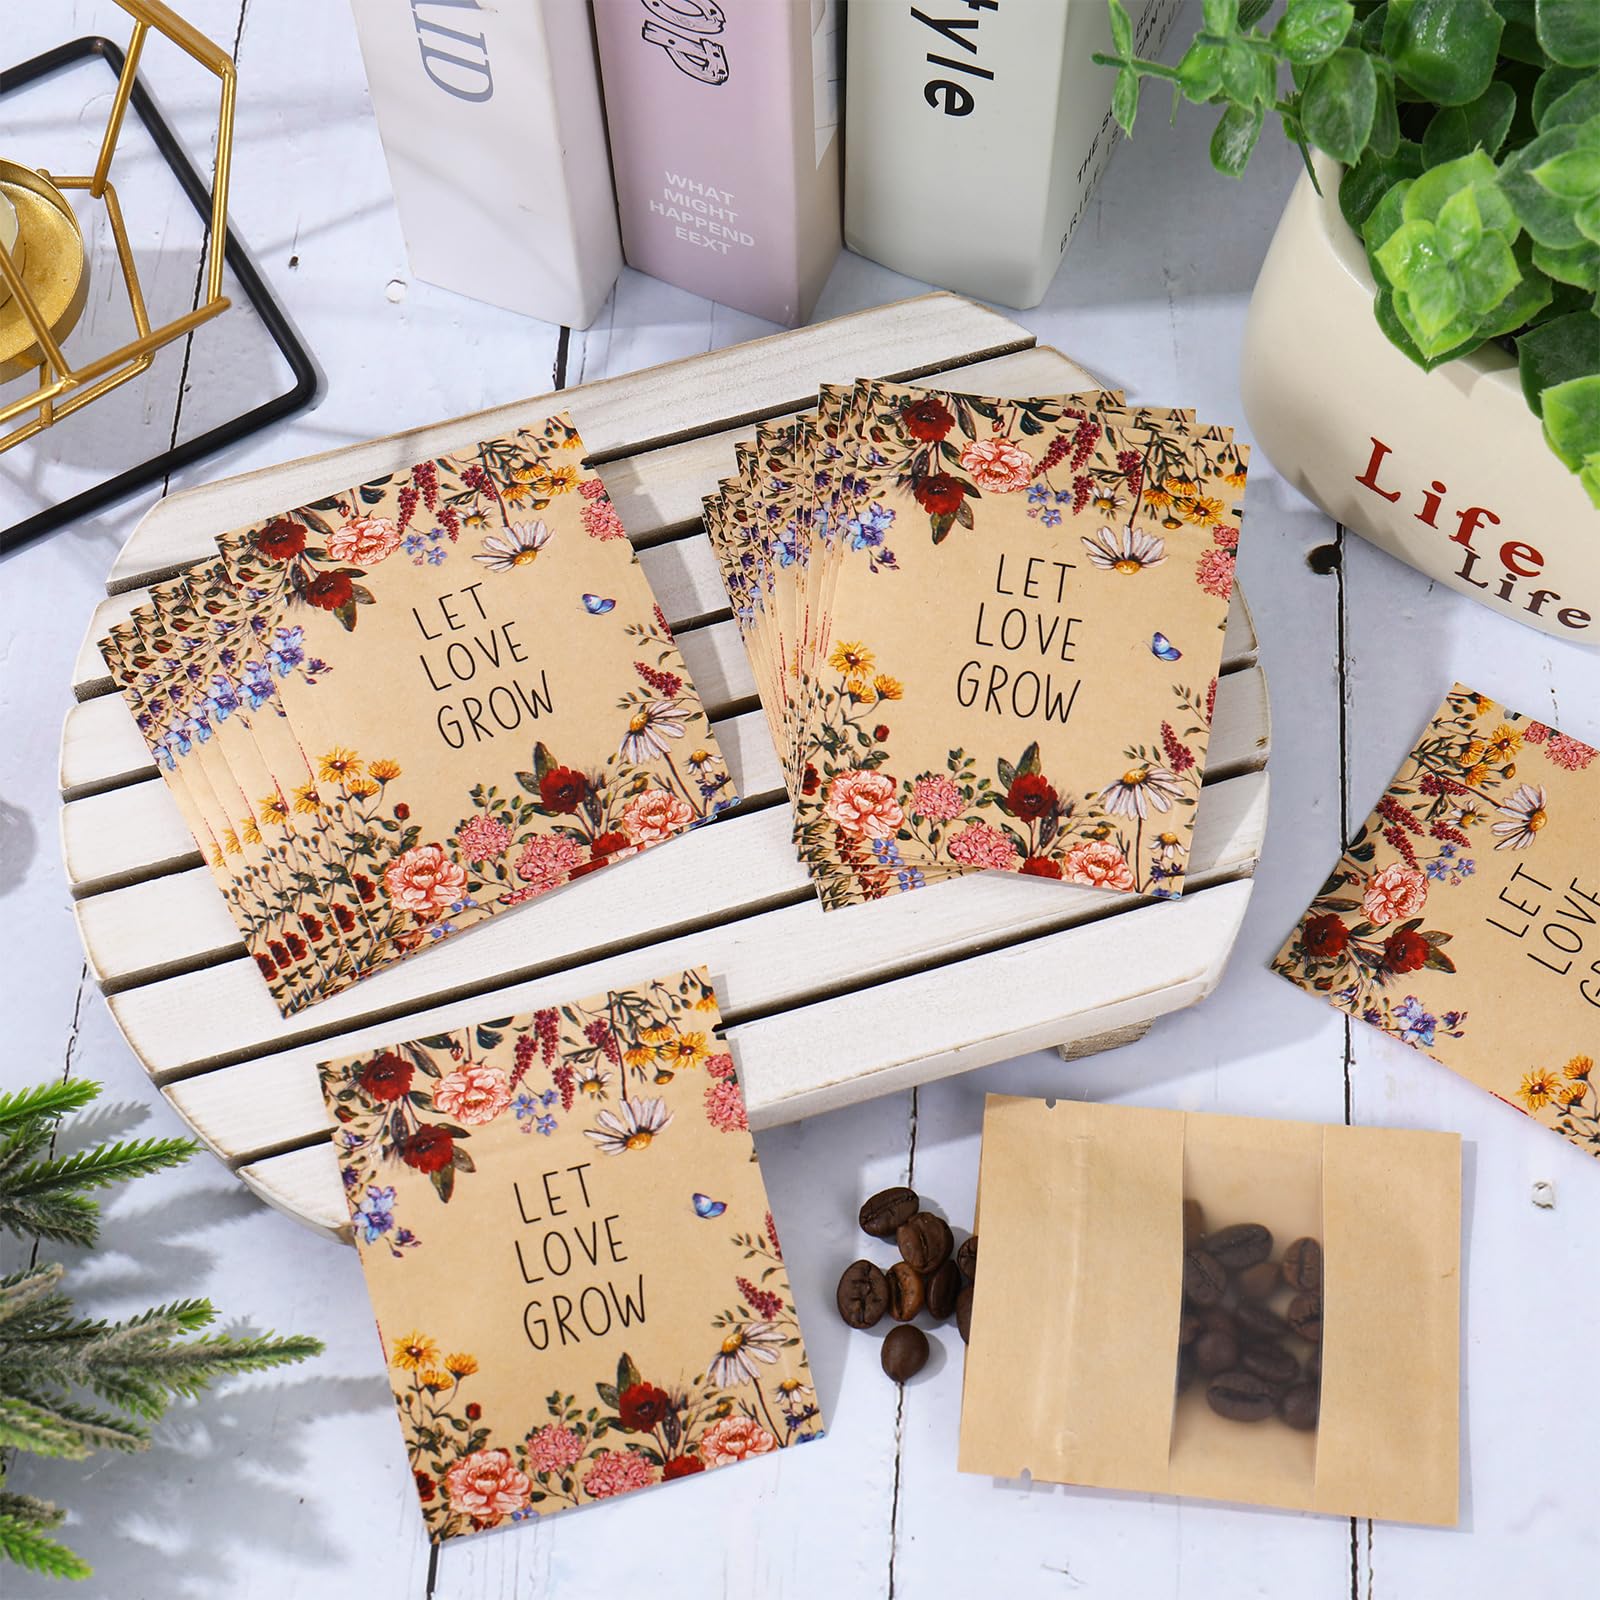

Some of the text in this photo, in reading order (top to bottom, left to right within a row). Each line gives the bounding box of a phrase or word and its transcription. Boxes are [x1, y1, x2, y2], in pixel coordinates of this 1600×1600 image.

[664, 170, 736, 206] WHAT
[664, 188, 739, 224] MIGHT
[649, 199, 755, 247] HAPPEND
[675, 226, 732, 255] EEXT
[1354, 436, 1545, 578] Life
[996, 553, 1077, 604] LET
[1454, 548, 1592, 629] Life
[412, 582, 488, 641] LET
[975, 602, 1083, 662] LOVE
[419, 621, 529, 692] LOVE
[437, 669, 553, 749] GROW
[957, 660, 1082, 724] GROW
[1485, 862, 1553, 939] LET
[513, 1162, 592, 1225] LET
[514, 1214, 629, 1285] LOVE
[523, 1273, 646, 1351] GROW
